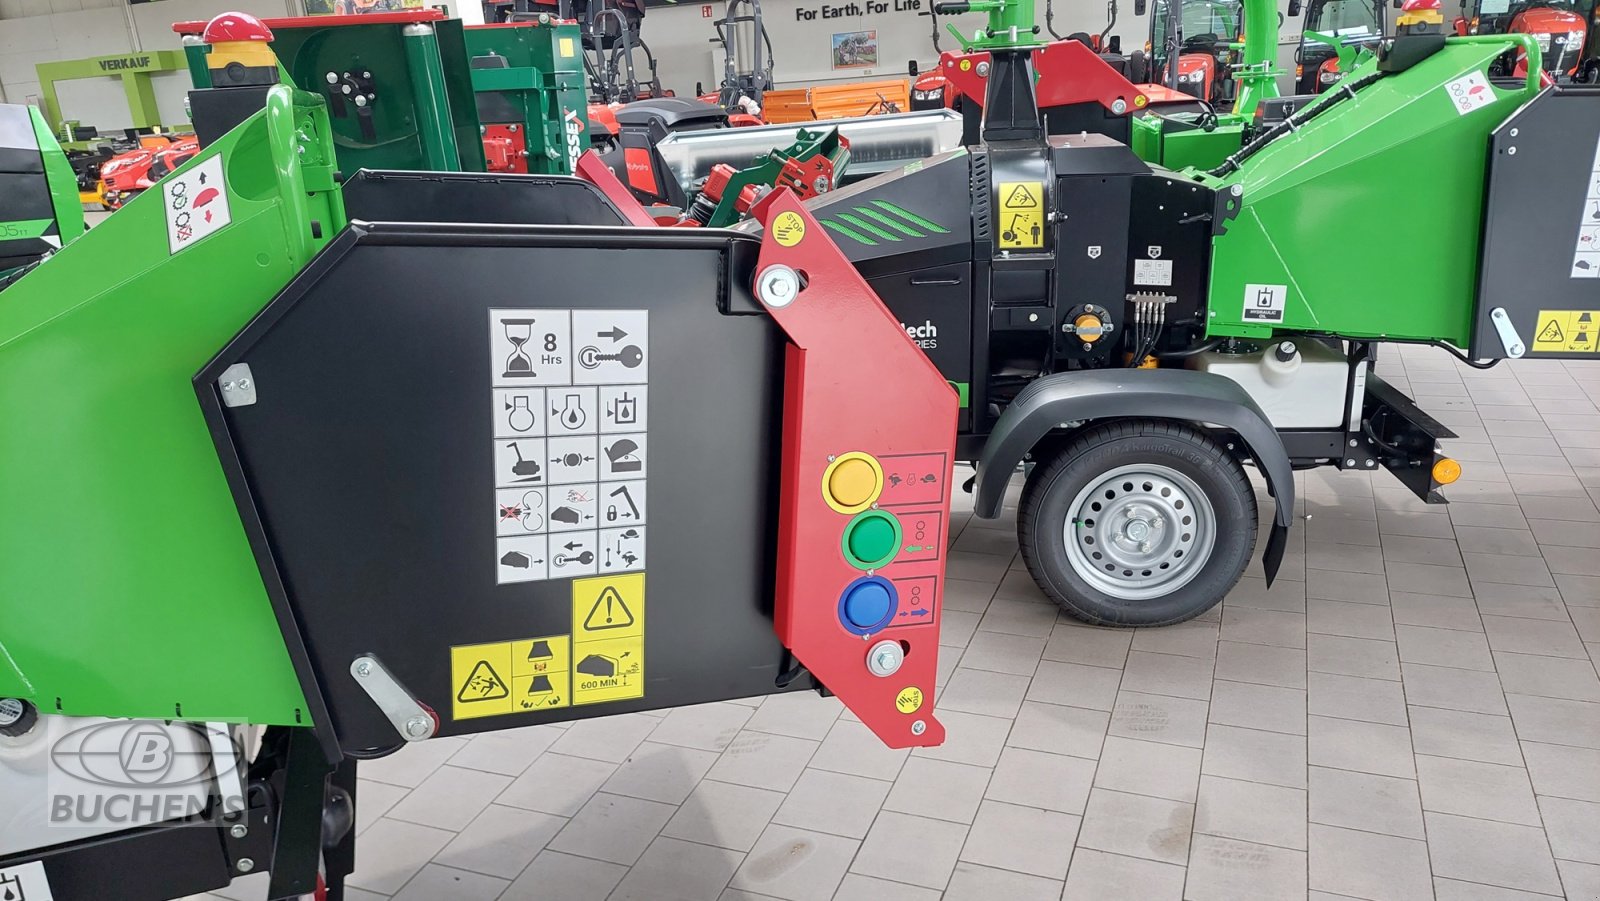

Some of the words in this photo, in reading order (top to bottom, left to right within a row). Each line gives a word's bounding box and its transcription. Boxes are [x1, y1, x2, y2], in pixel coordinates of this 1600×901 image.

[796, 8, 818, 21] For
[822, 2, 863, 19] Earth,
[867, 1, 889, 14] For
[895, 0, 921, 11] Life
[98, 56, 150, 71] VERKAUF
[786, 213, 803, 233] STOP
[544, 333, 557, 352] 8
[541, 354, 562, 365] Hrs
[581, 680, 598, 690] 600
[600, 678, 618, 688] MIN
